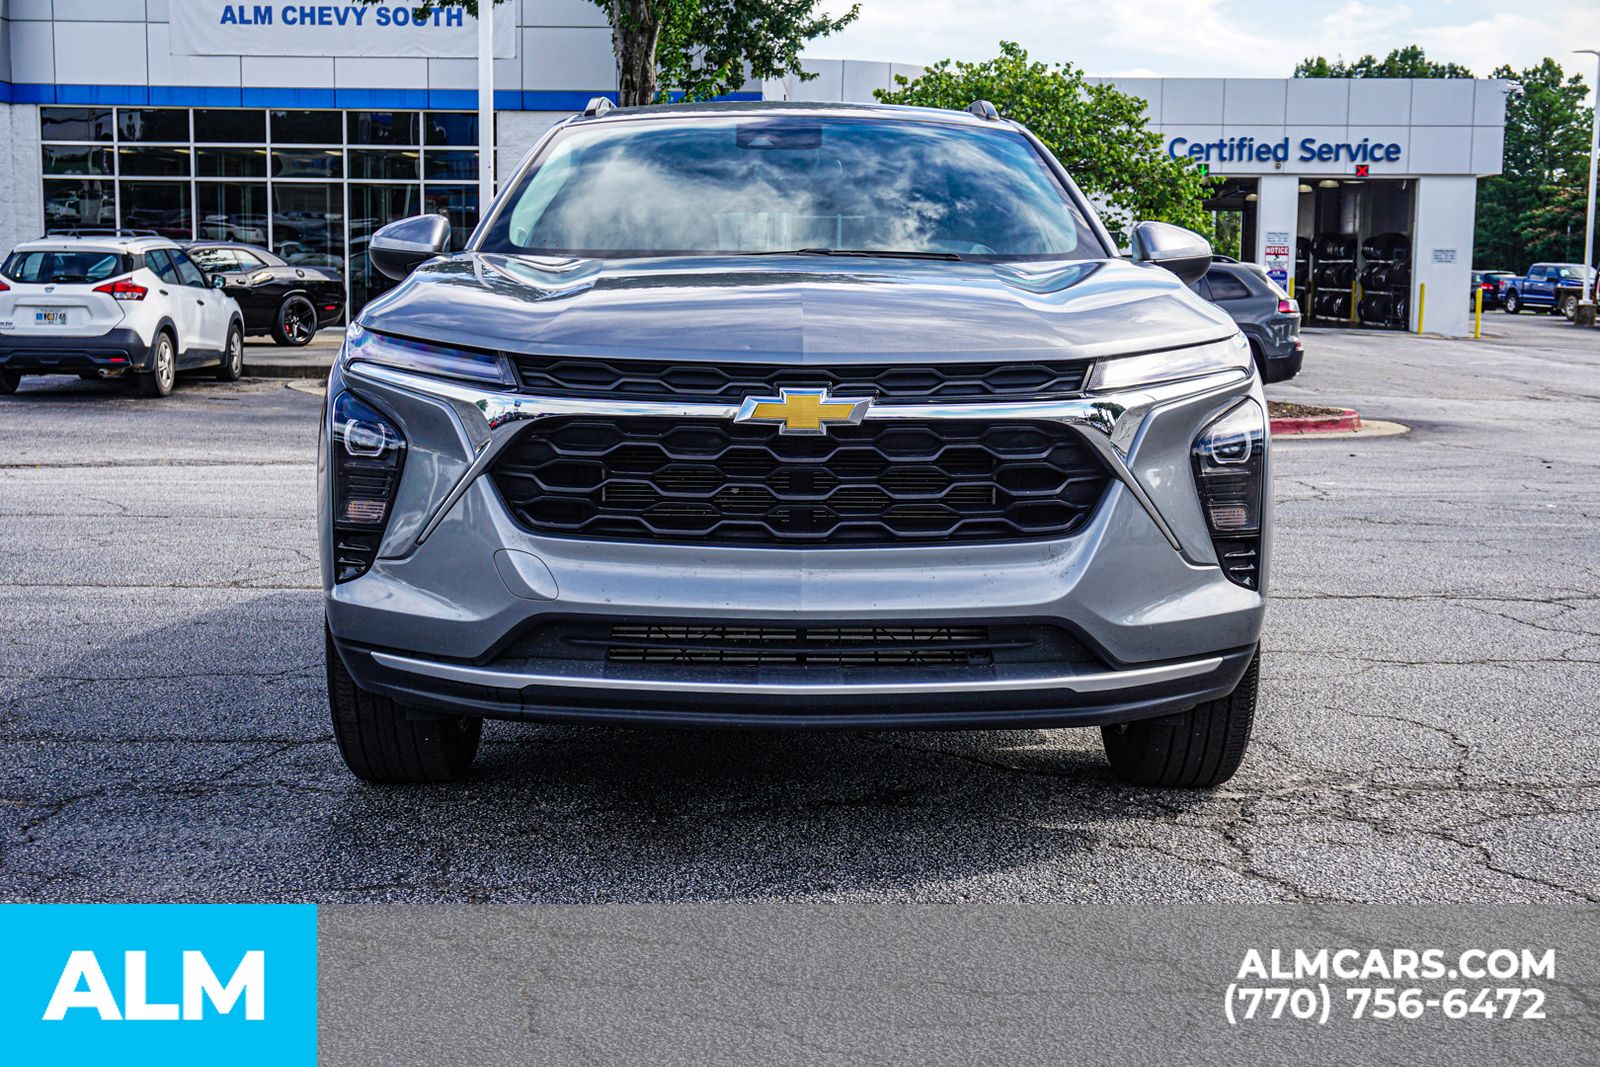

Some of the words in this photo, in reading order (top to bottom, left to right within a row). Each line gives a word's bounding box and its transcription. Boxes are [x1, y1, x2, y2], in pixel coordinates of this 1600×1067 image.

[220, 5, 273, 25] ALM
[281, 6, 367, 26] CHEVY
[375, 7, 463, 27] SOUTH
[1168, 137, 1289, 162] Certified
[1300, 137, 1402, 162] Service
